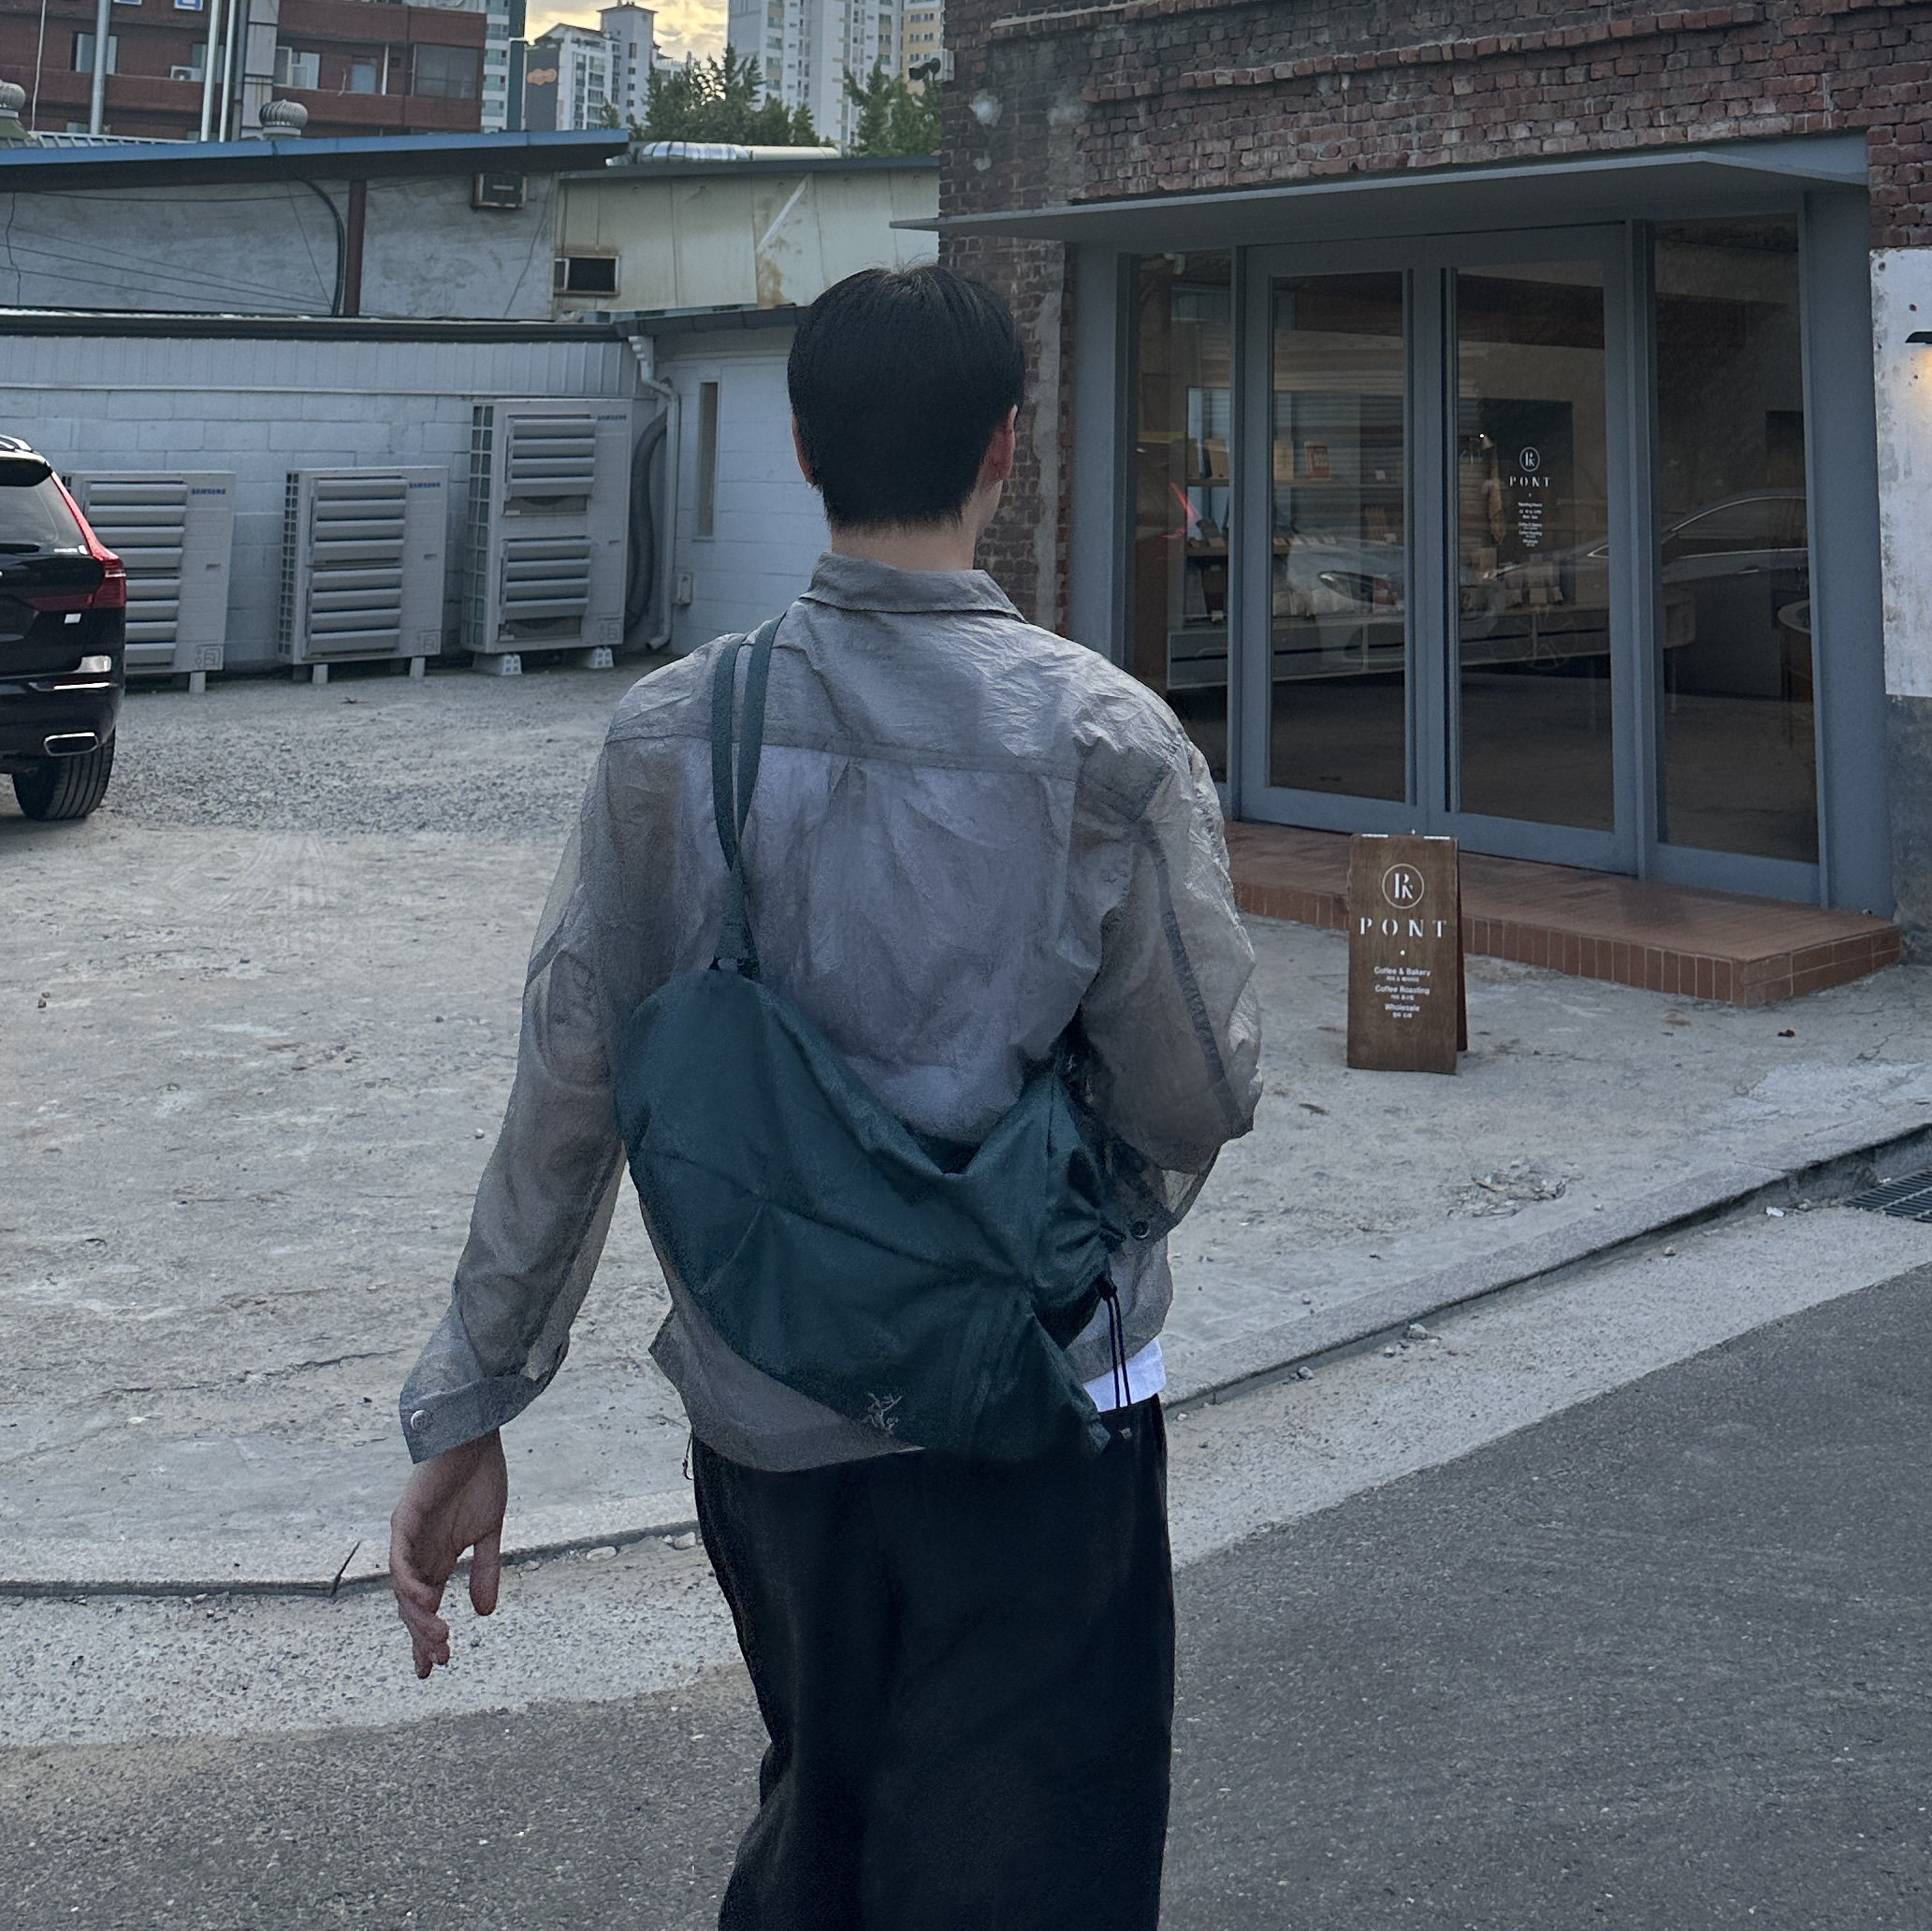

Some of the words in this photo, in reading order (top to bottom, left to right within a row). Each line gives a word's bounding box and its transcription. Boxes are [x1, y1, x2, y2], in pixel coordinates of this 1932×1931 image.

[1509, 476, 1550, 487] PONT
[1360, 918, 1446, 937] PONT
[1373, 966, 1398, 975] Coffee
[1406, 967, 1431, 977] Bakery
[1374, 984, 1398, 993] Coffee
[1399, 985, 1431, 995] Roasting
[1385, 1003, 1420, 1011] Wholesale
